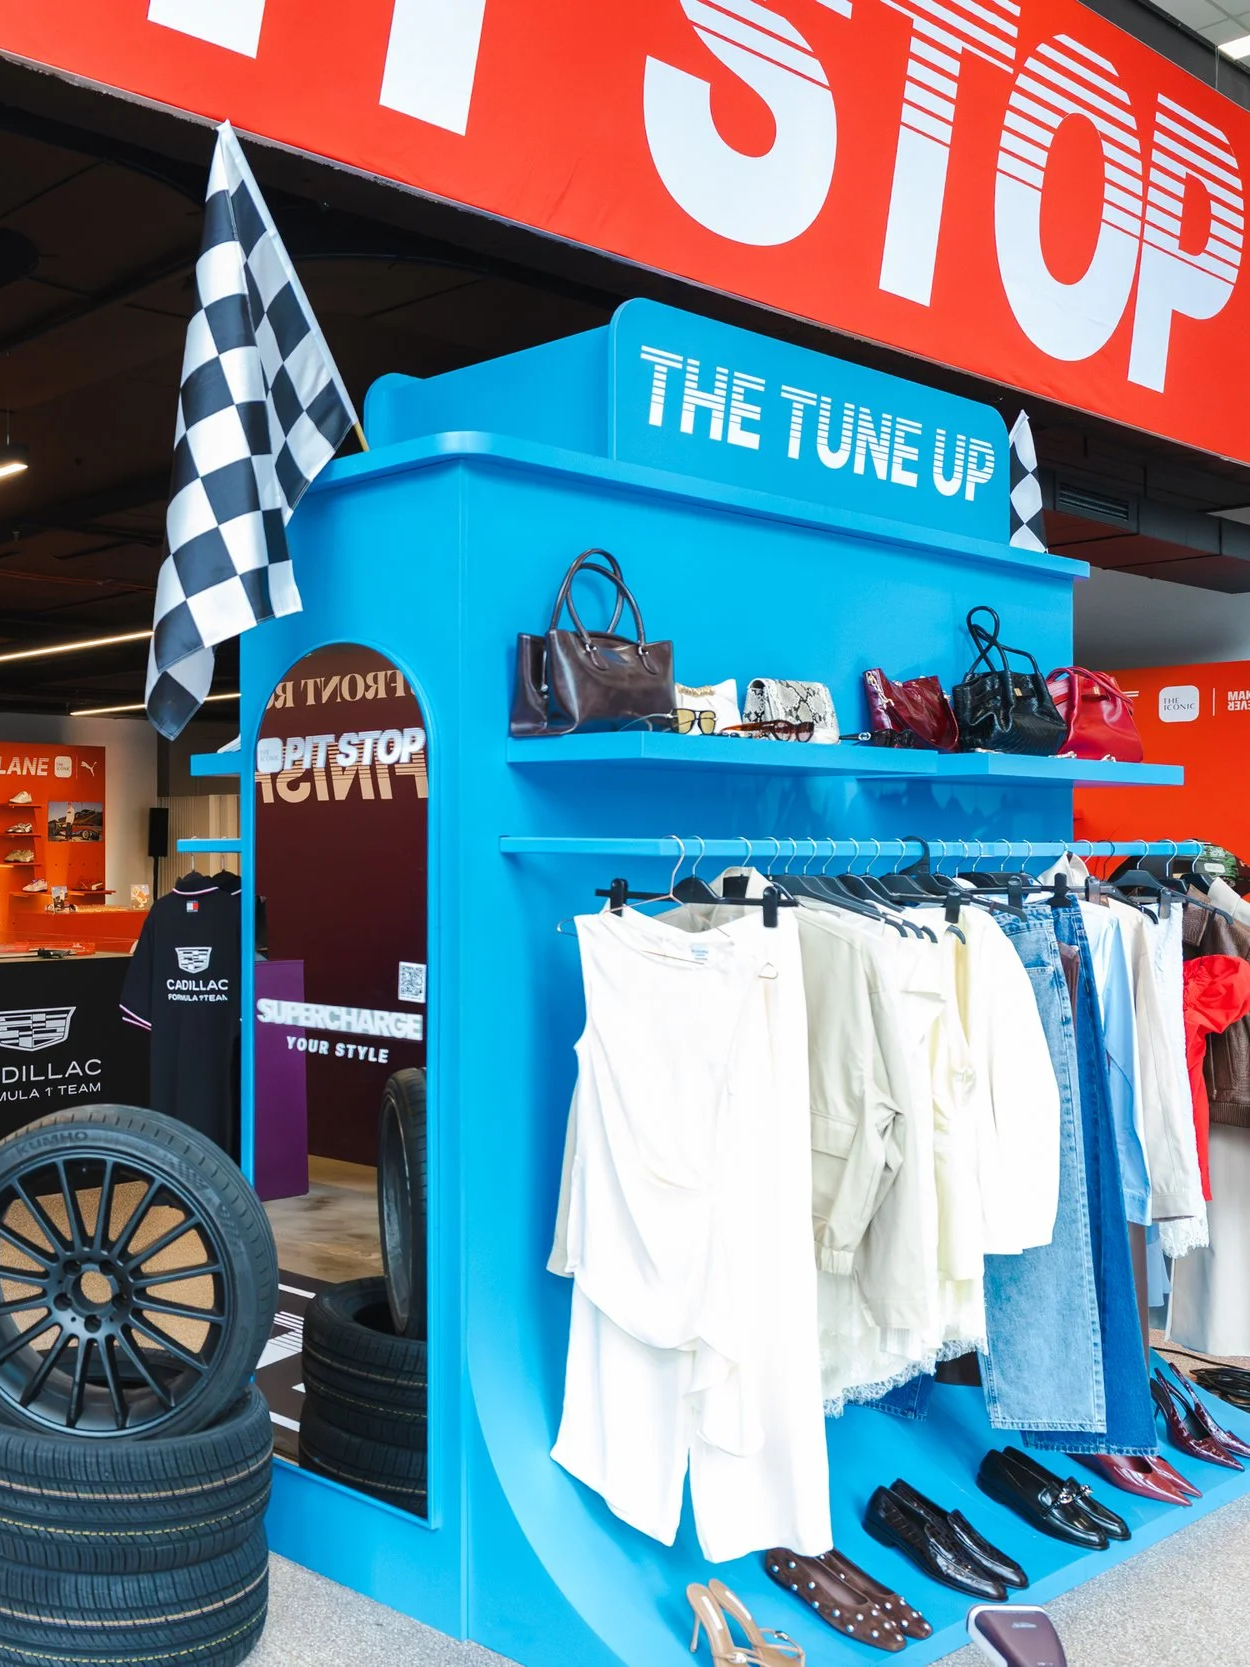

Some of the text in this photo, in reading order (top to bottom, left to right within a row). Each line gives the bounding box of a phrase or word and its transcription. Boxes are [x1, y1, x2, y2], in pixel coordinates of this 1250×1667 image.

[643, 0, 1244, 393] STOP
[640, 345, 995, 502] THE TUNE UP
[283, 734, 335, 770] PIT
[336, 727, 426, 767] STOP
[166, 979, 229, 991] CADILLAC
[168, 993, 198, 1002] FORMULA
[256, 998, 423, 1041] SUPERCHARGE
[286, 1036, 389, 1064] YOUR STYLE
[58, 1082, 101, 1095] TEAM
[15, 1131, 88, 1157] KUMHO
